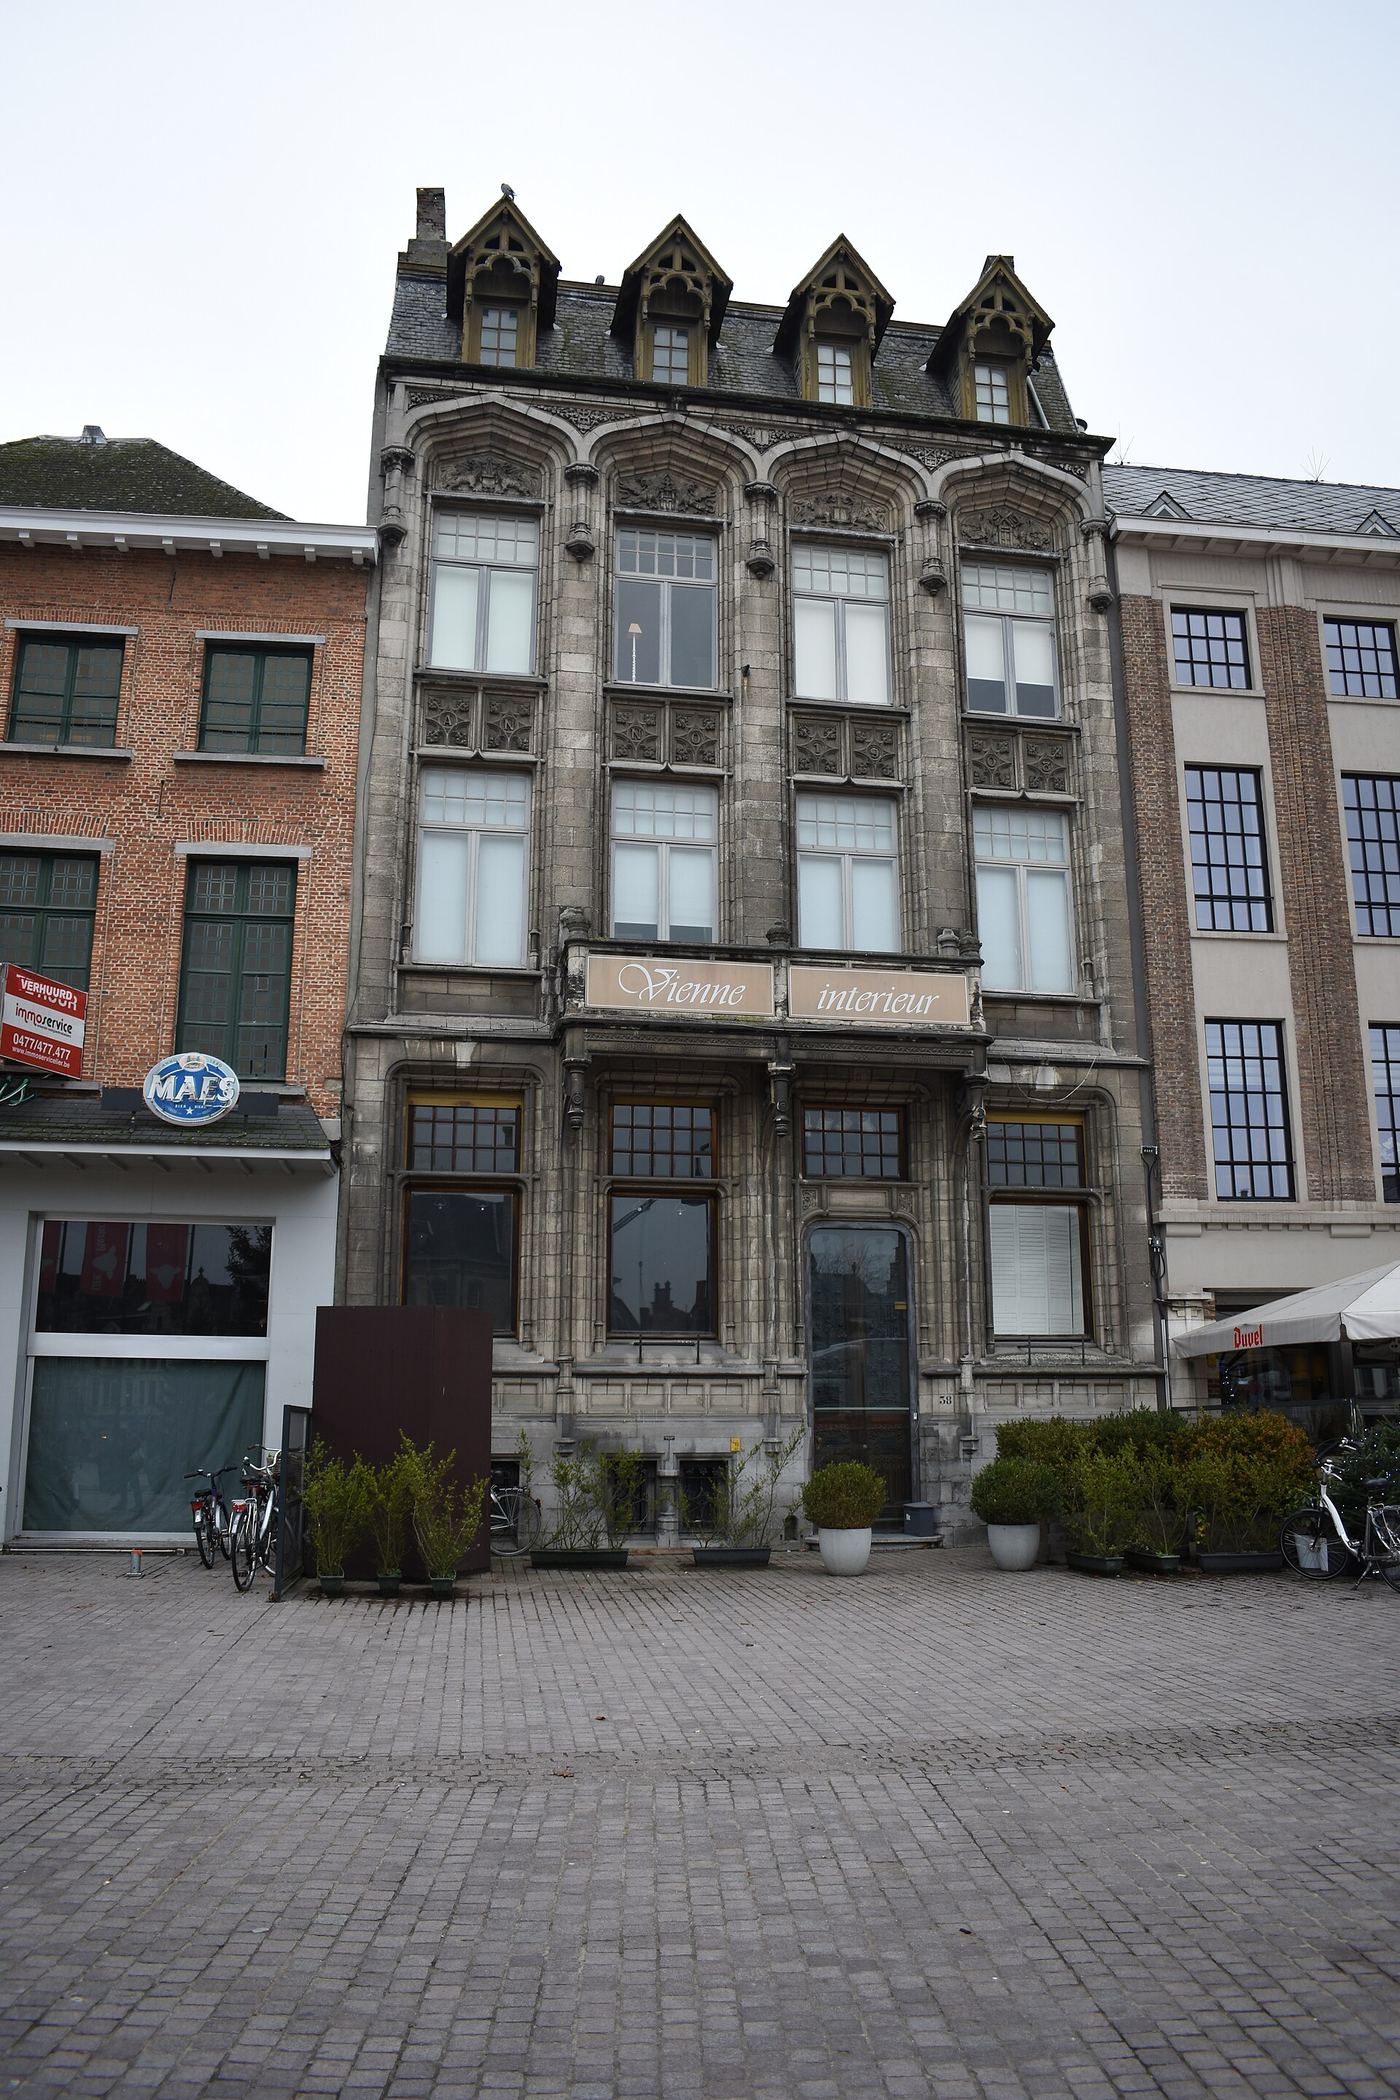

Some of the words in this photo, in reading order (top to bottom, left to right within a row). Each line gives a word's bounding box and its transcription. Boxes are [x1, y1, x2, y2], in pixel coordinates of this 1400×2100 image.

[21, 978, 73, 1000] VERHUURD
[618, 963, 746, 1006] Vienne
[816, 983, 940, 1015] interieur
[15, 1003, 73, 1034] immoservice
[13, 1033, 71, 1060] 0477/477.477
[146, 1074, 235, 1103] MAES
[1233, 1324, 1264, 1349] Duvel
